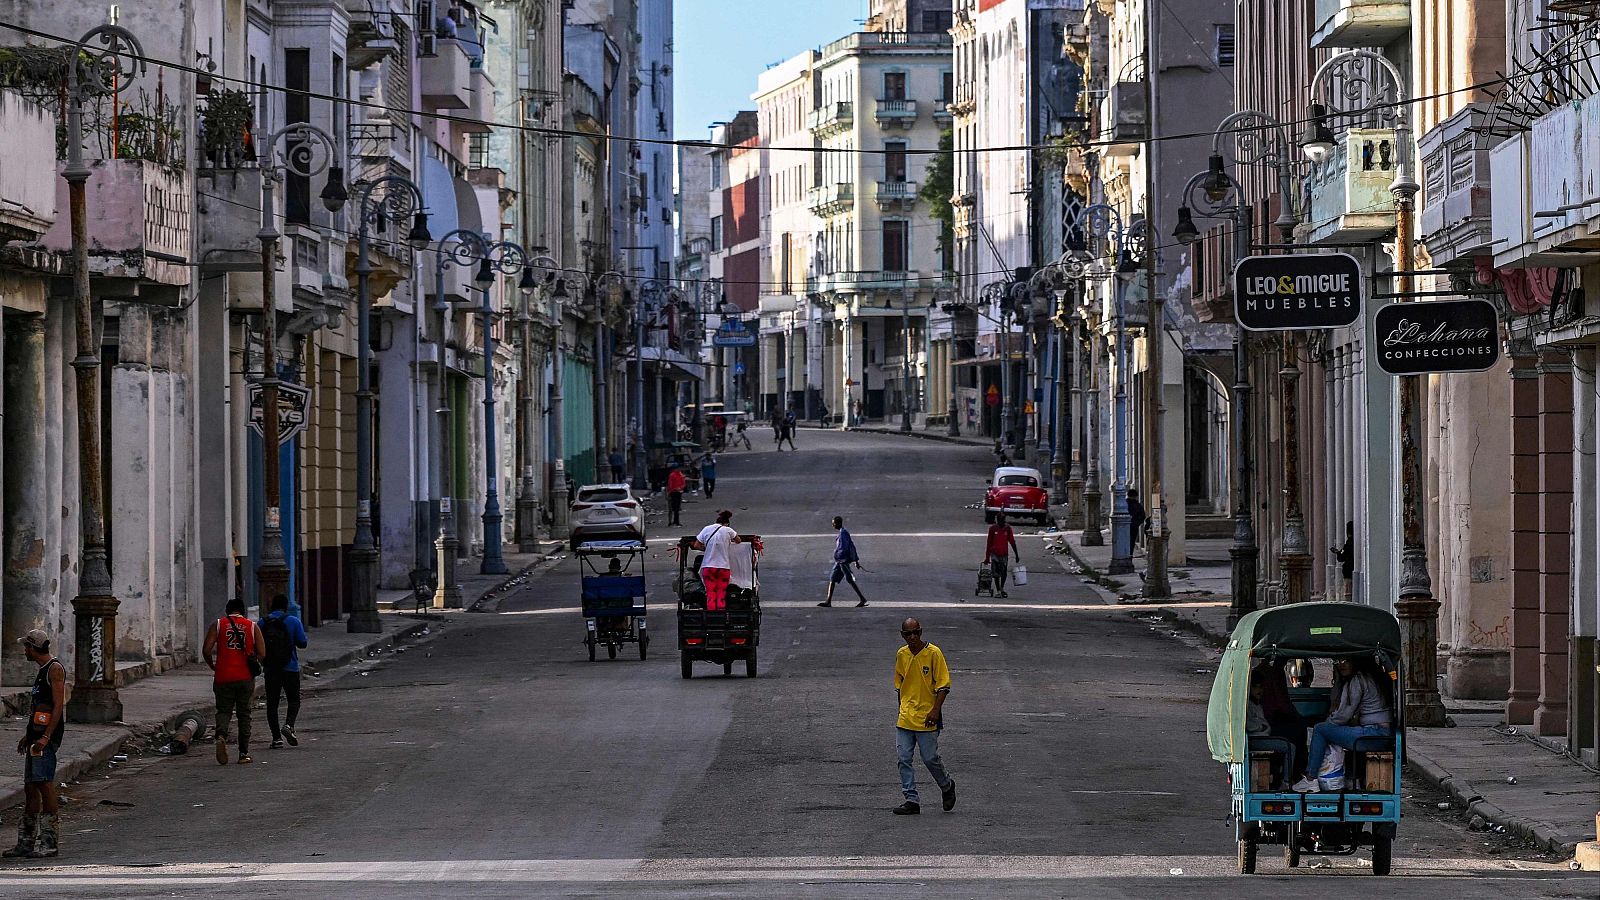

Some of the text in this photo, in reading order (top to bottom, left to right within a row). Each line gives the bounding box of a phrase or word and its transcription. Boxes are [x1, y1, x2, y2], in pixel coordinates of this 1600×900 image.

[1246, 296, 1351, 311] MUEBLES
[1384, 318, 1489, 347] Lohana
[1385, 346, 1491, 360] CONFECCIONES
